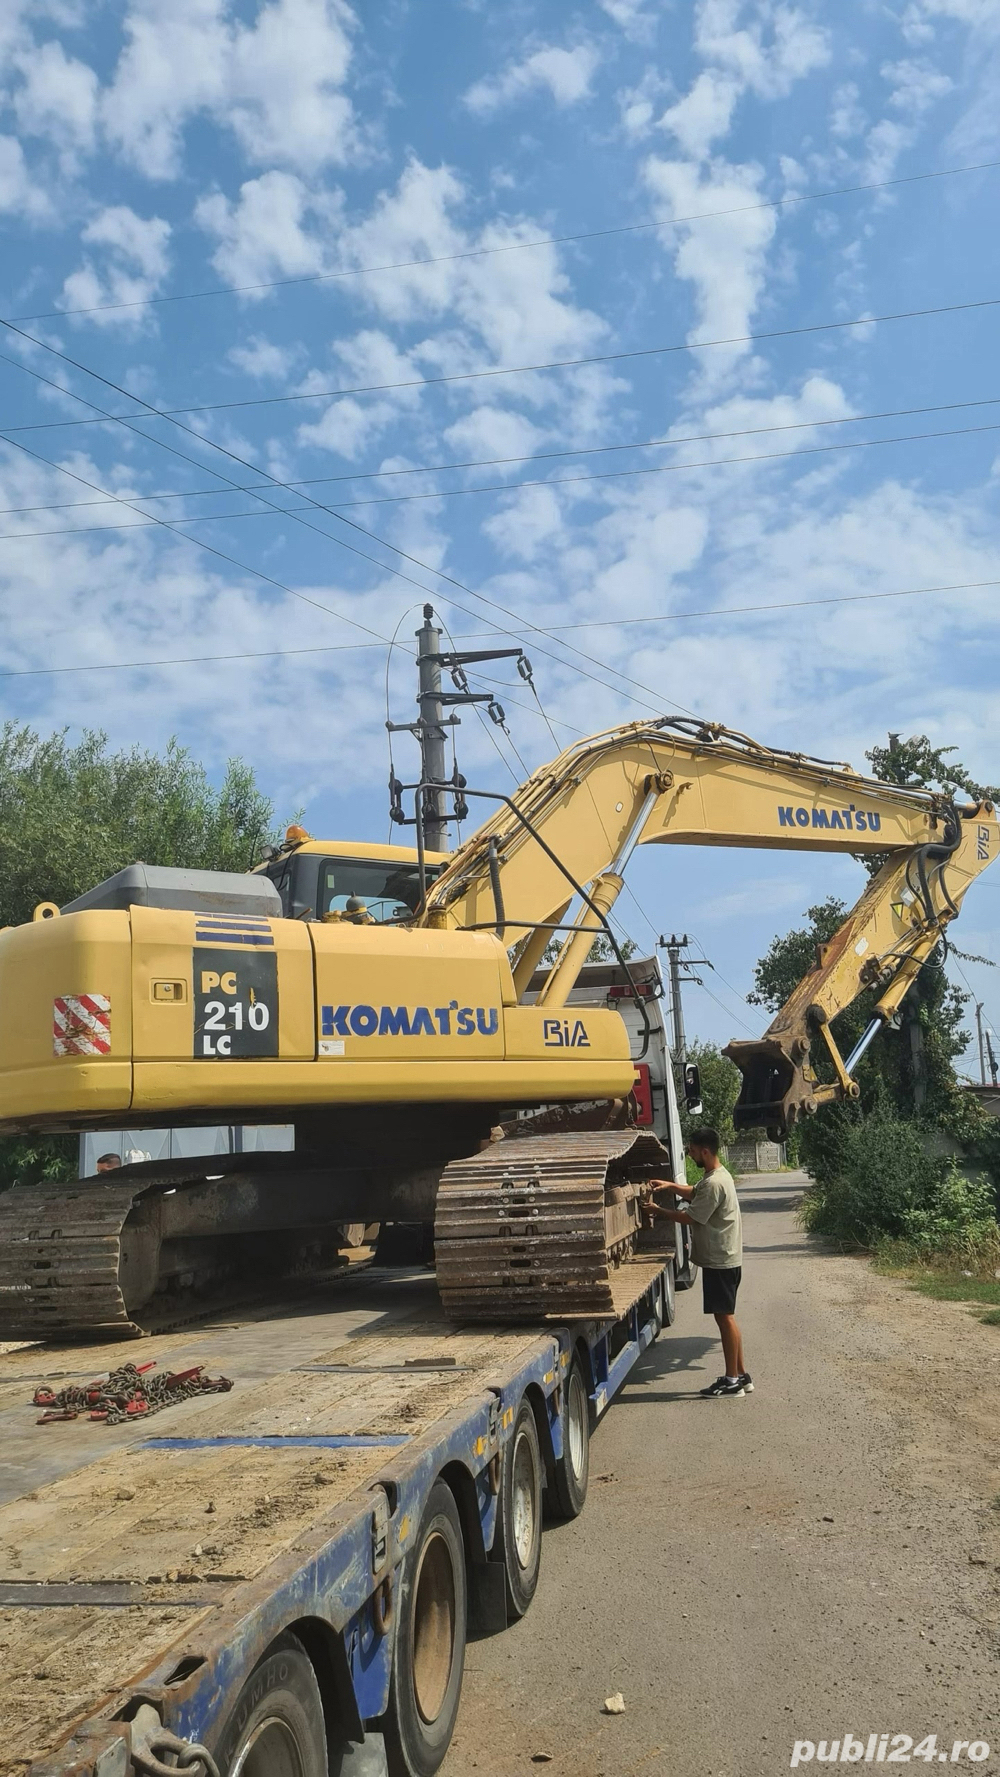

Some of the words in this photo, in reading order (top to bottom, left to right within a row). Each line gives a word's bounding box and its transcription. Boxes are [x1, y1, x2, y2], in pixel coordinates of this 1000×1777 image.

[778, 804, 881, 832] KOMATSU
[201, 970, 238, 995] PC
[203, 1000, 270, 1031] 210
[321, 1000, 499, 1037] KOMATSU
[203, 1034, 232, 1056] LC
